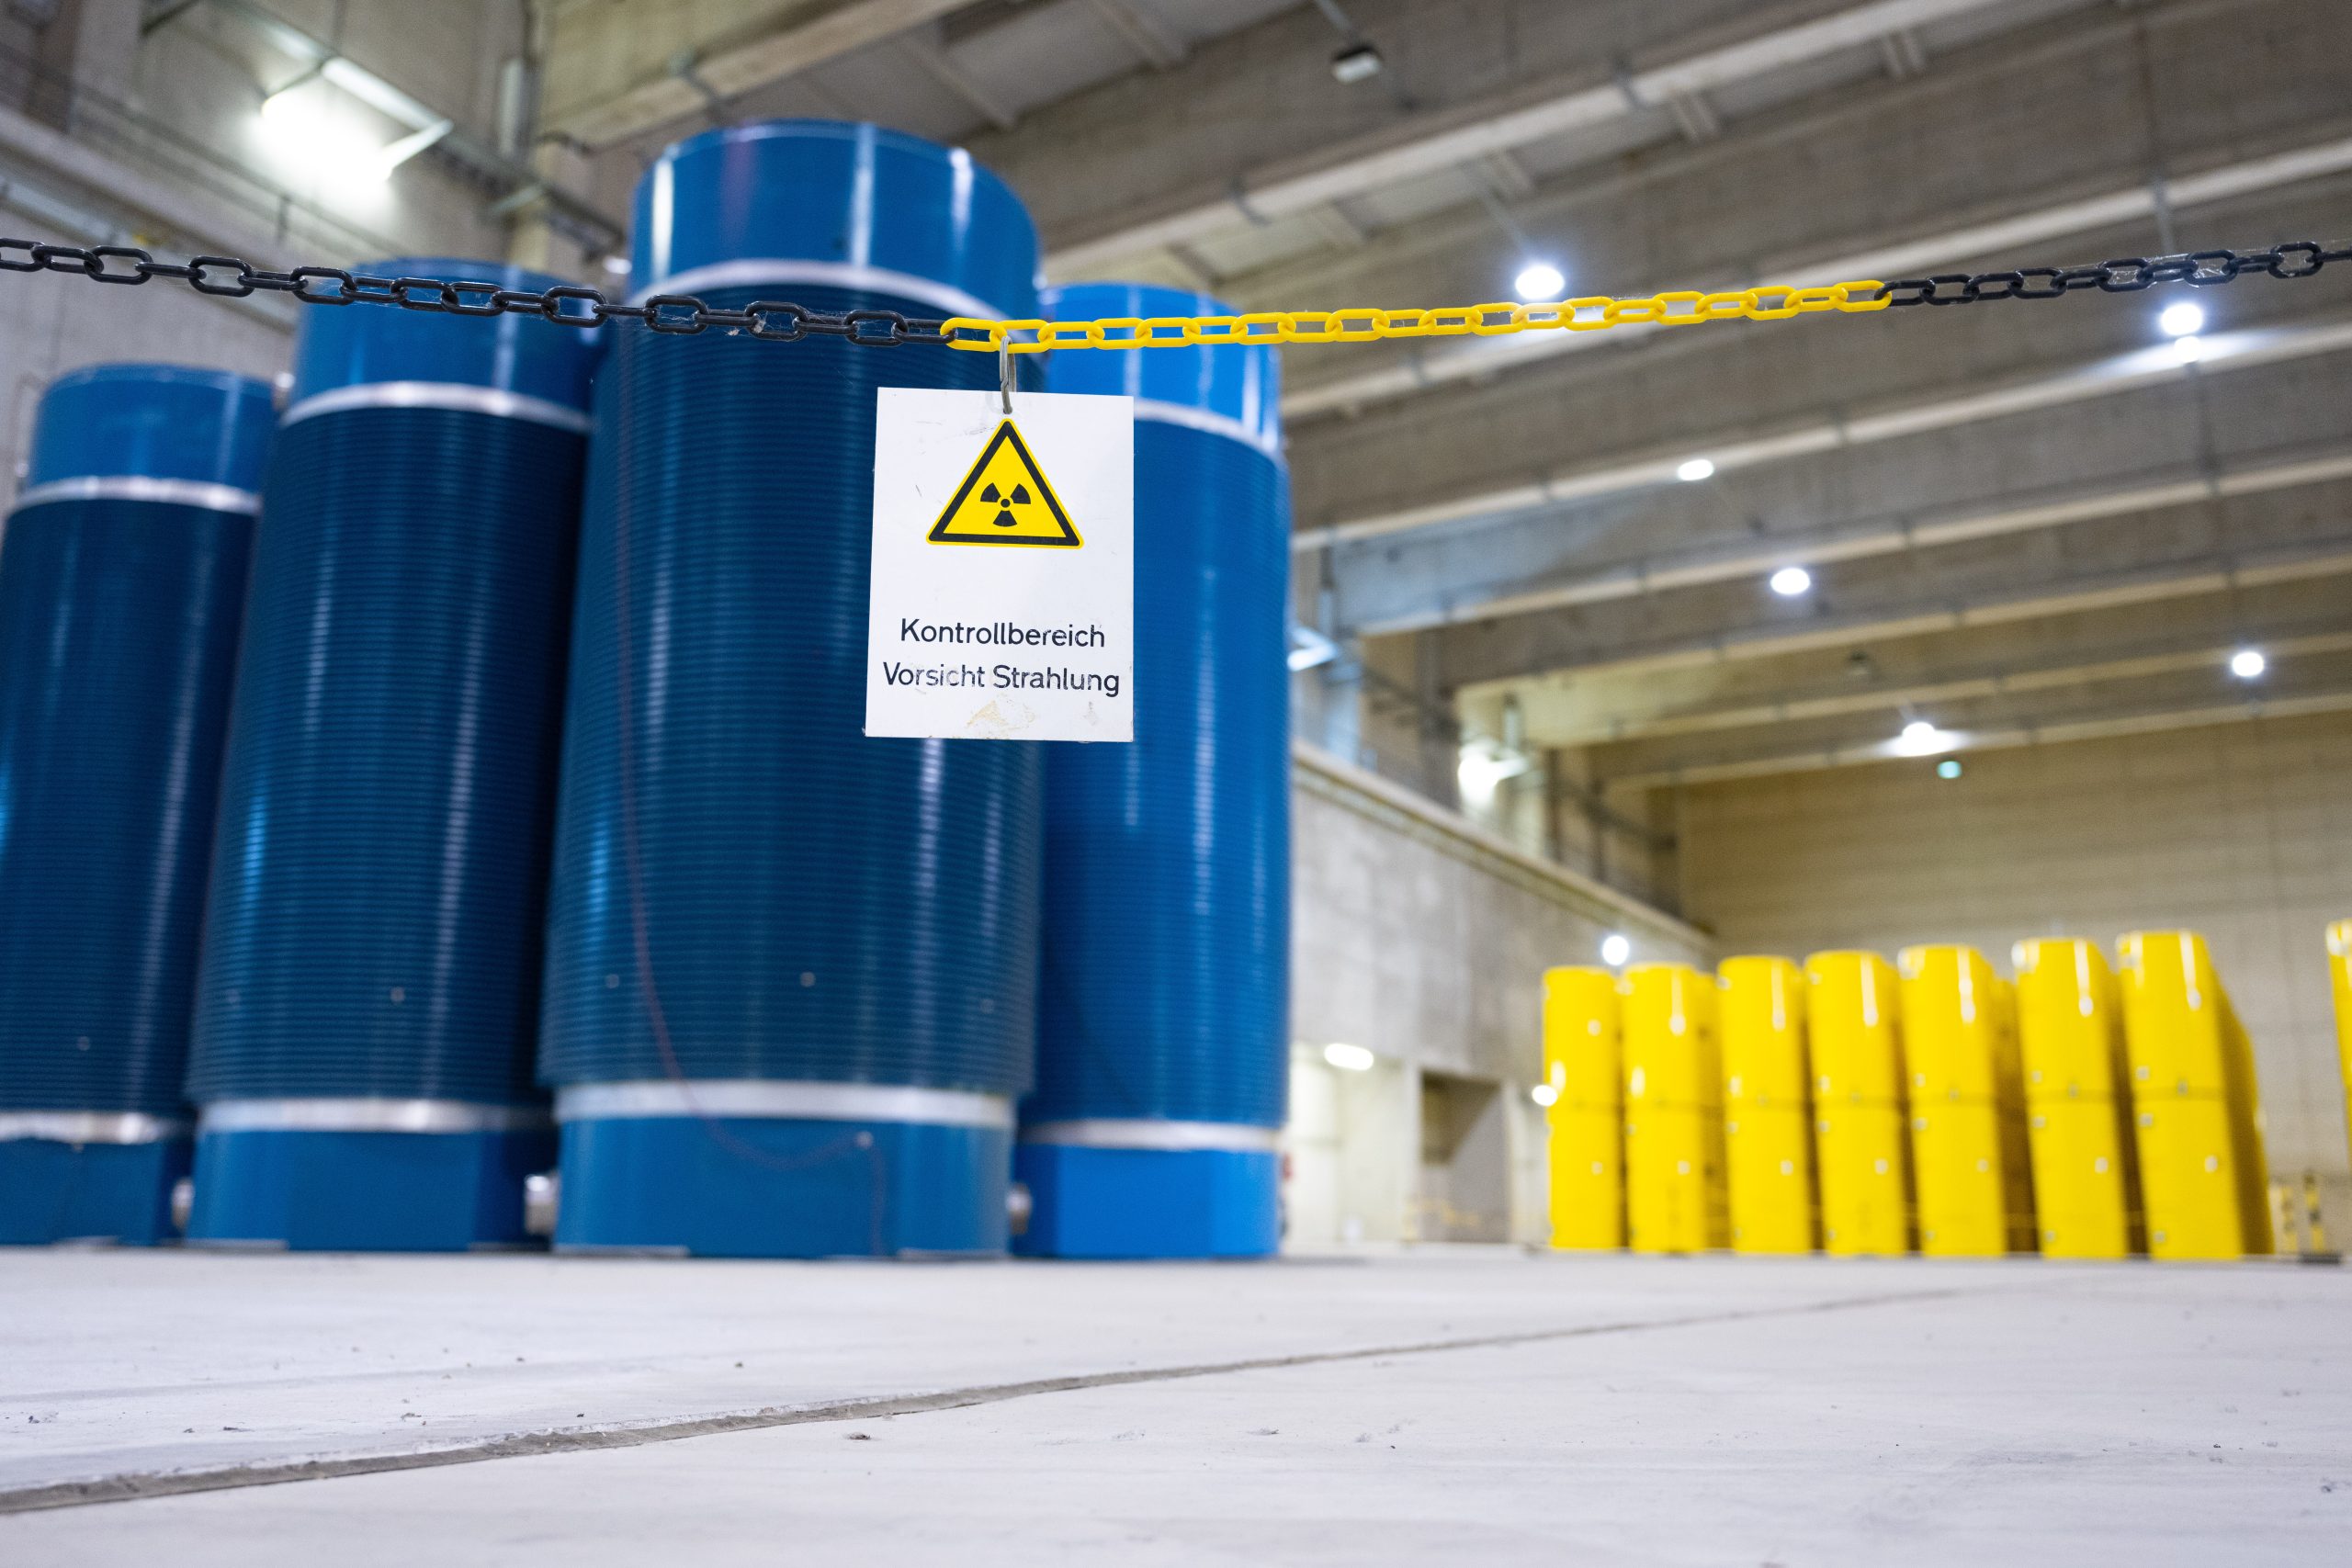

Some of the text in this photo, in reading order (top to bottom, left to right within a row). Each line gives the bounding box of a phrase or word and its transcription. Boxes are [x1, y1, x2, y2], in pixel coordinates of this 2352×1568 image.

[900, 618, 1105, 647] Kontrollbereich
[883, 661, 1120, 697] Vorsicht Strahlung
